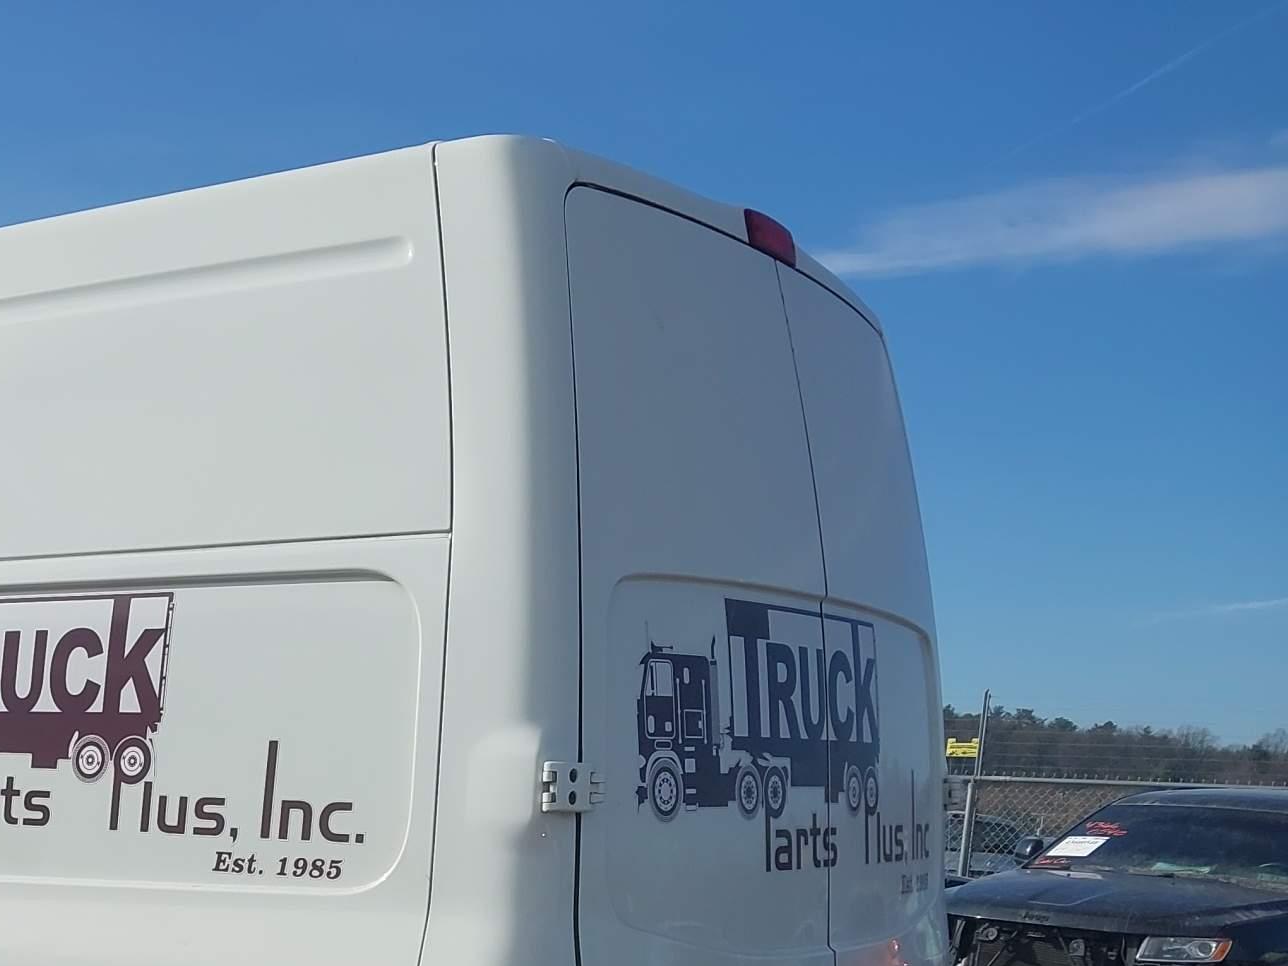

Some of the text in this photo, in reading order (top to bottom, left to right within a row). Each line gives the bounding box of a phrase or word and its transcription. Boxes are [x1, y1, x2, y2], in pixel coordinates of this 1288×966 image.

[259, 740, 366, 844] Inc.
[212, 851, 344, 880] Est. 1985
